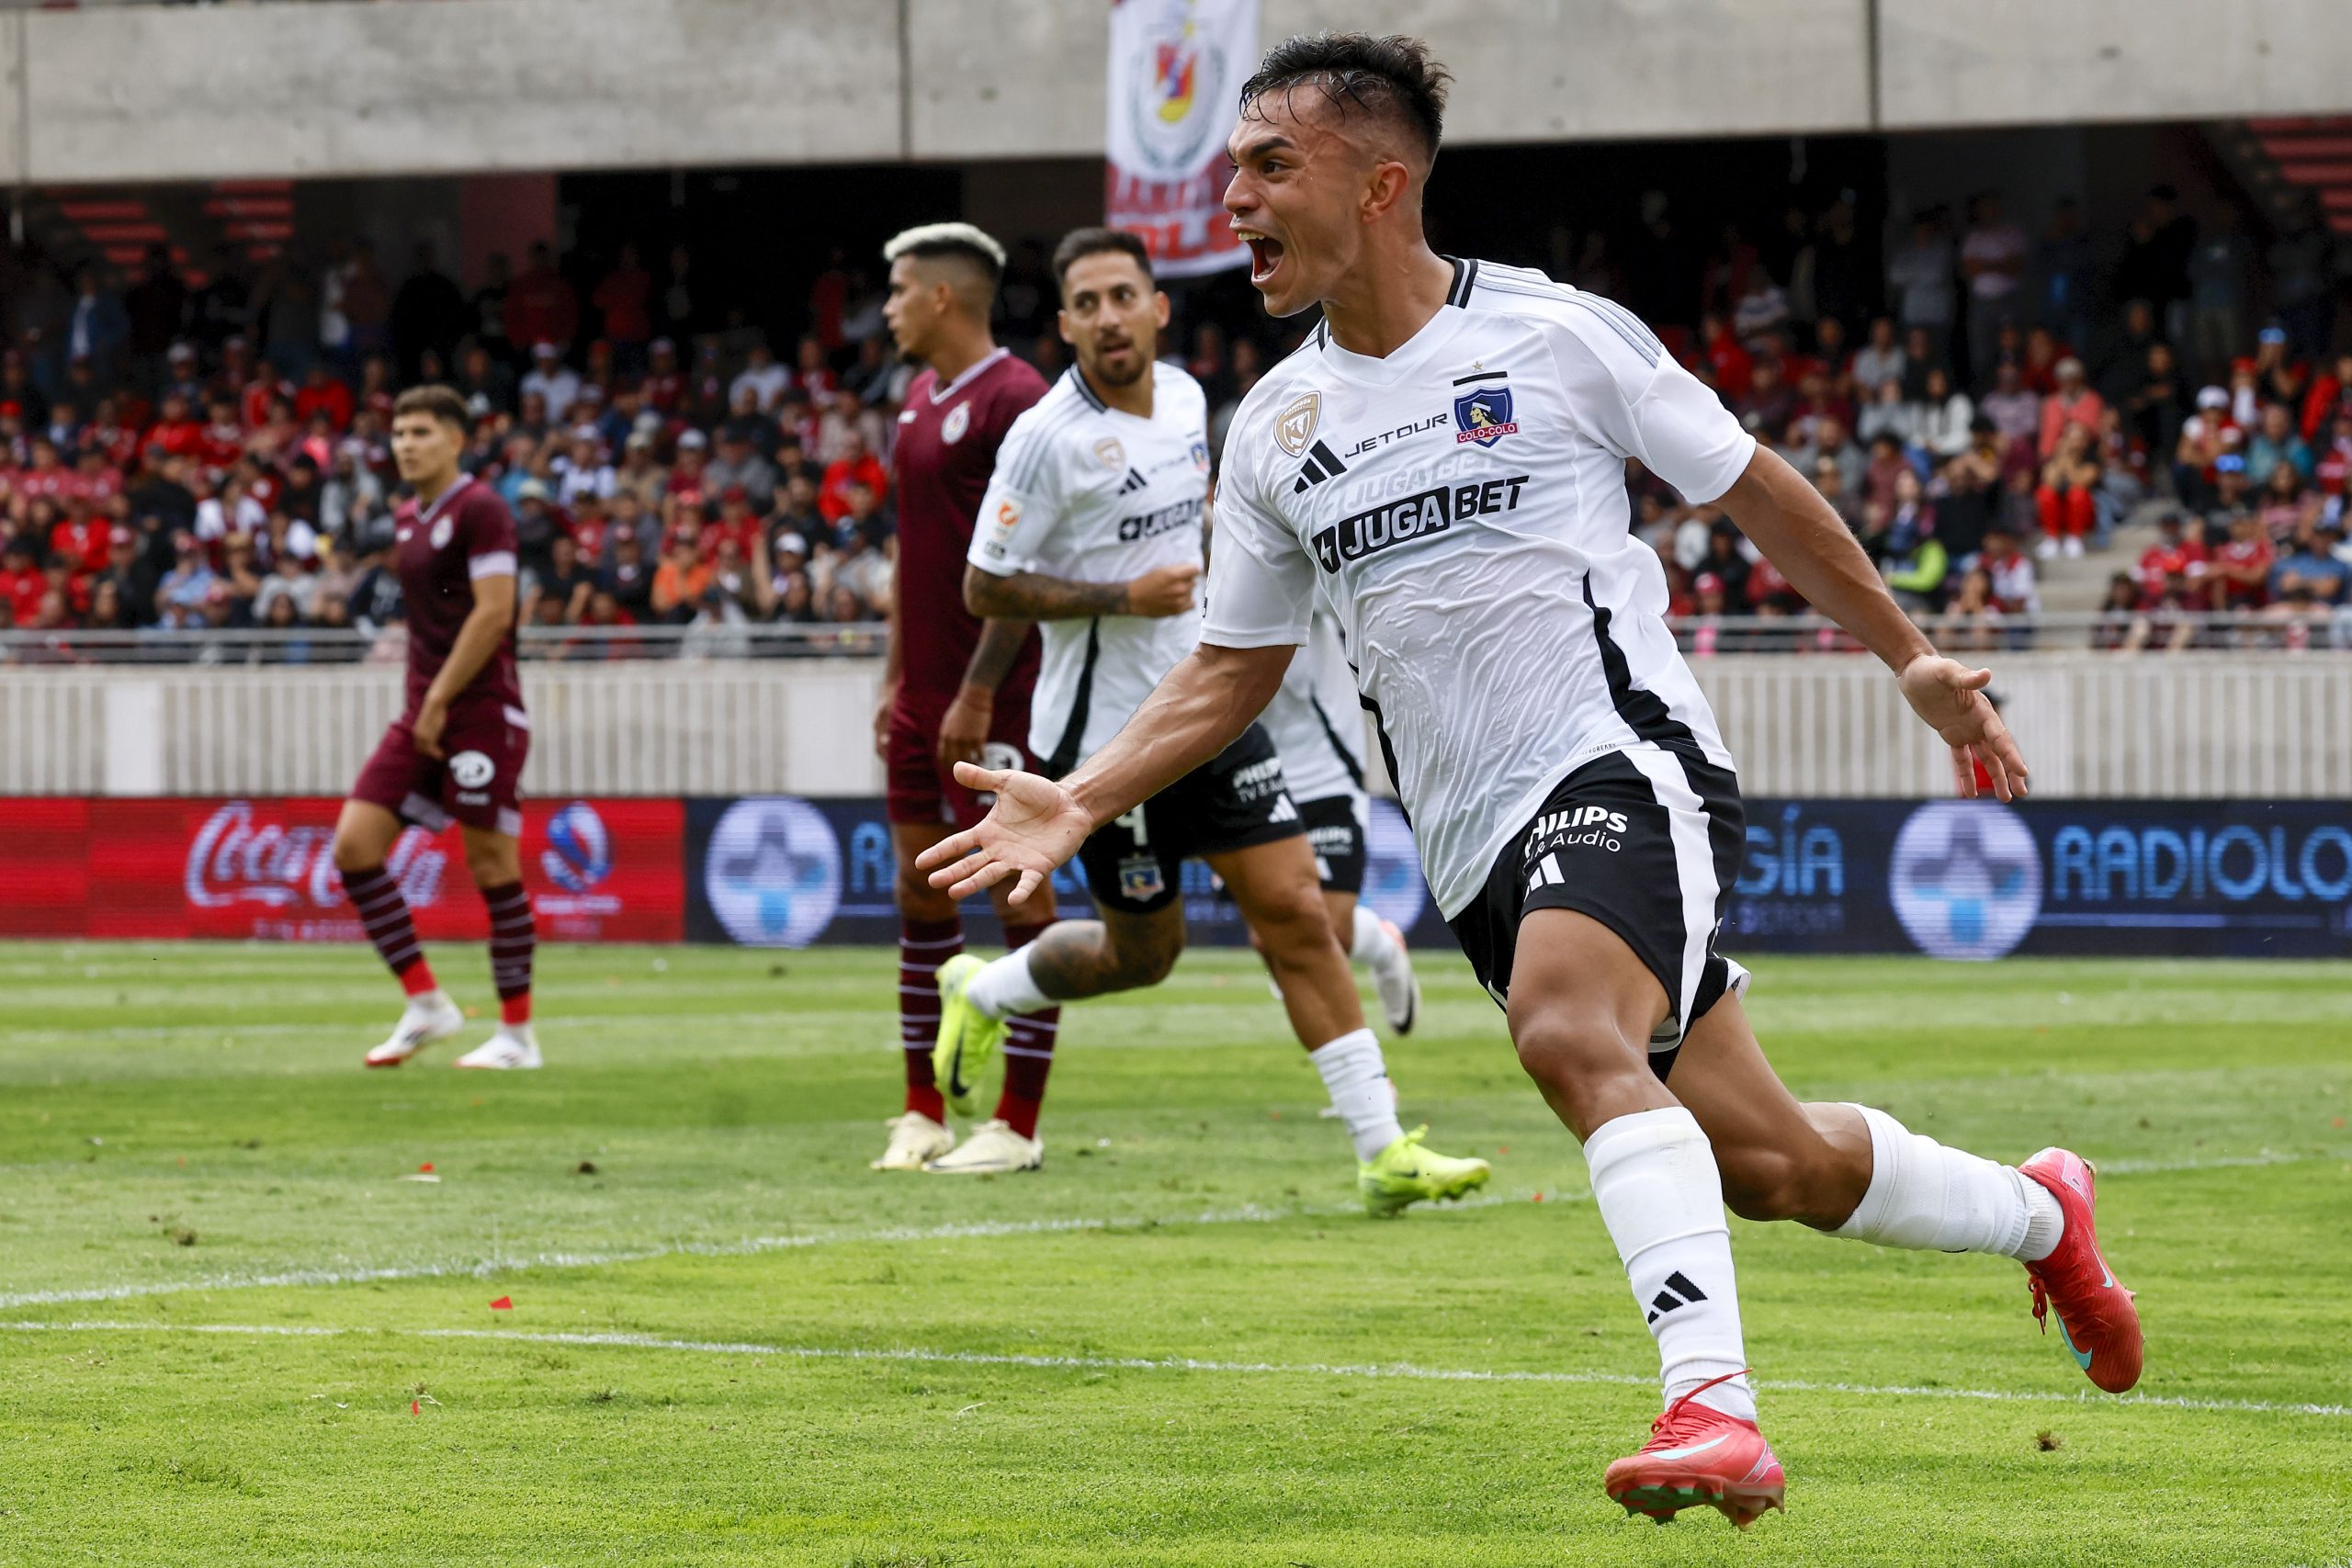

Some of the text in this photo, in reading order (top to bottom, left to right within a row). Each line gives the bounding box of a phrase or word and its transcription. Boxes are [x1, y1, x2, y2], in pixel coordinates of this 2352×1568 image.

[1344, 412, 1448, 458] JETOUR
[1458, 424, 1516, 443] COLO-COLO
[1550, 829, 1622, 852] Audio
